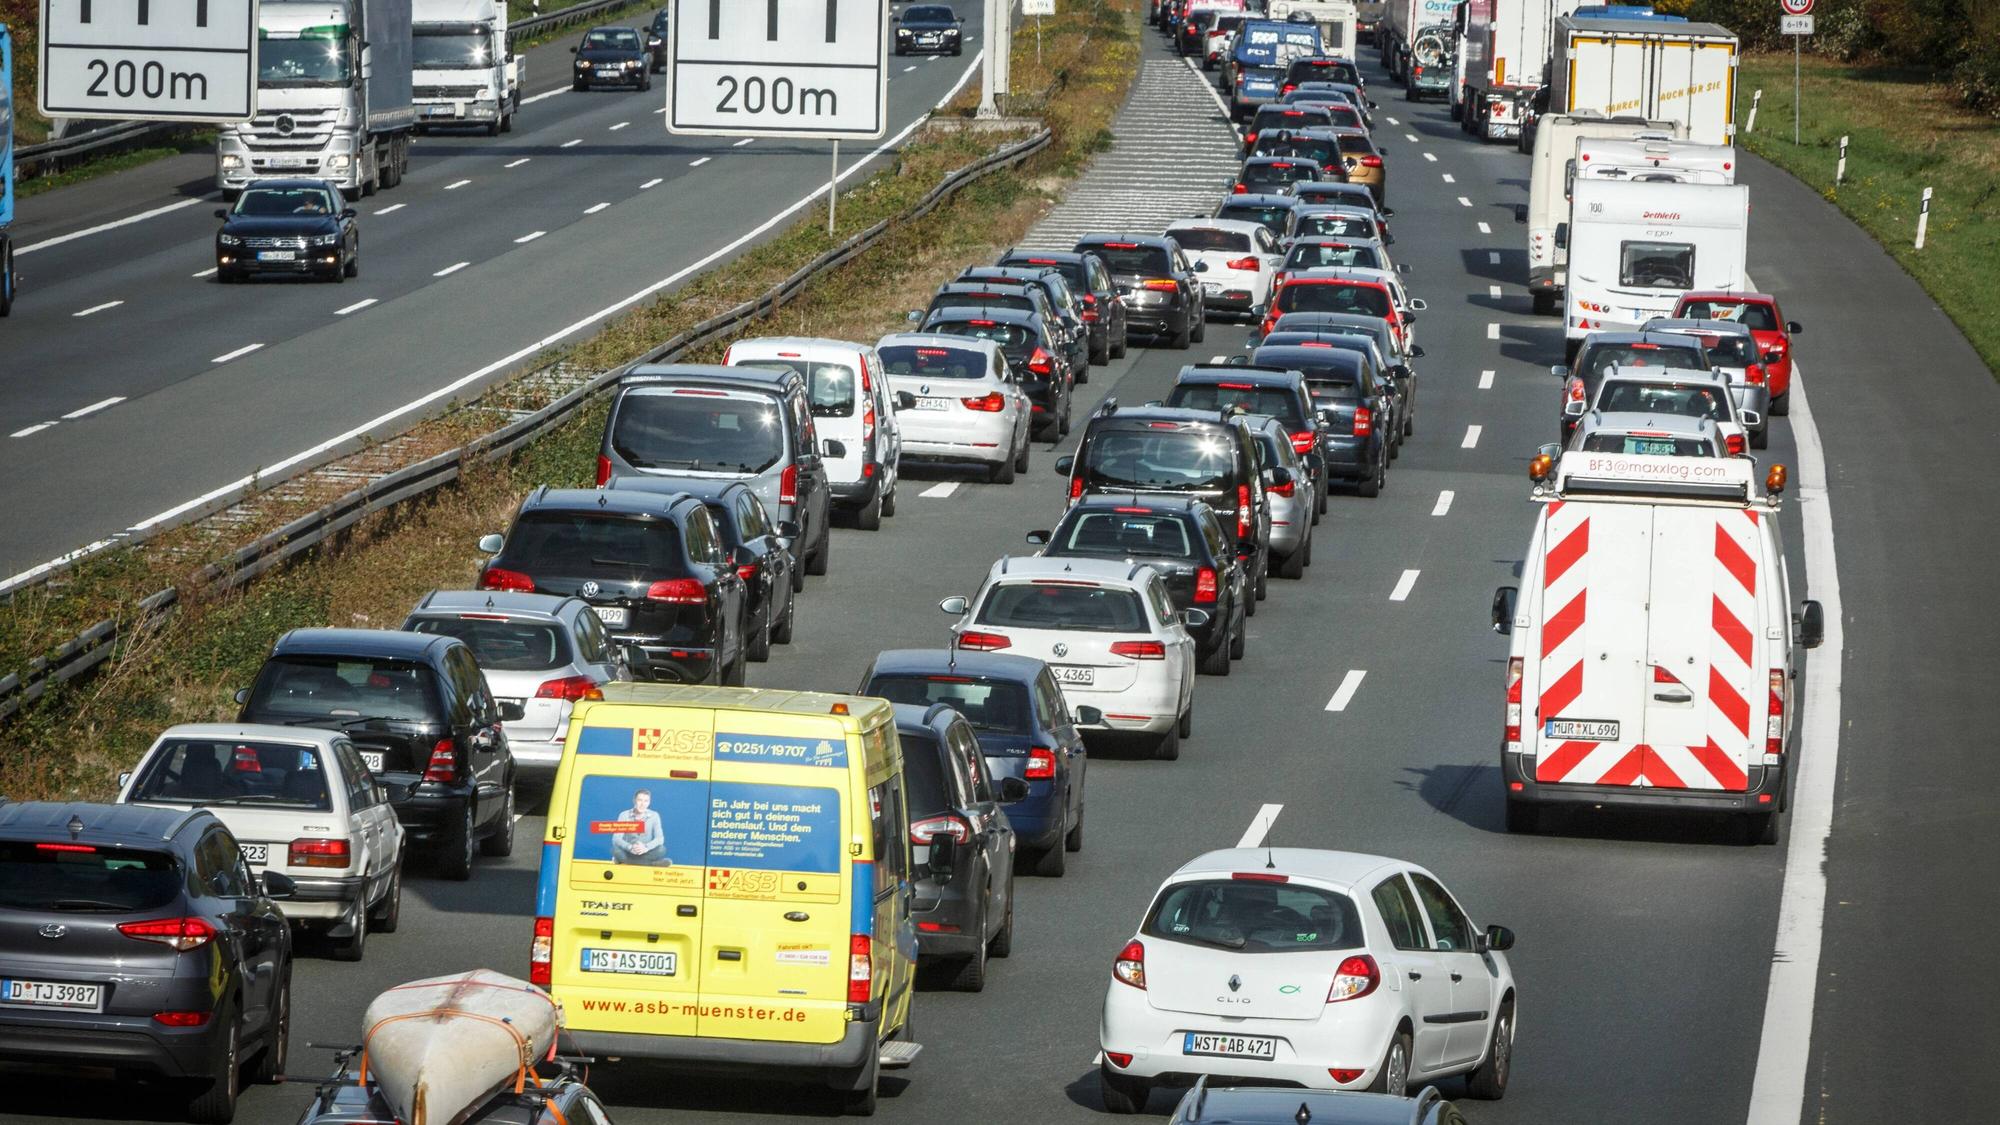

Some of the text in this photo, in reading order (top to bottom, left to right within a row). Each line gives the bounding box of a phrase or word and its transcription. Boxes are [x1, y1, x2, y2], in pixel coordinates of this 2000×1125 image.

[87, 59, 207, 100] 200m
[716, 75, 837, 116] 200m
[1605, 99, 1640, 113] FAHREN
[1660, 88, 1684, 101] AUCH
[1706, 81, 1721, 92] SIE
[1643, 211, 1680, 220] Dethleffs
[933, 400, 948, 409] 341
[1589, 460, 1725, 479] BF3@maxxlog.com
[1063, 669, 1091, 681] 4365
[1582, 723, 1595, 735] XL
[1597, 724, 1617, 736] 696
[653, 730, 712, 753] ASB
[733, 743, 807, 757] 0251/19707
[712, 798, 821, 813] Ein Jahr bei uns macht
[712, 810, 800, 822] sich gut in deinem
[711, 820, 811, 833] Lebenslauf. Und dem
[711, 831, 801, 842] anderer Menschen.
[243, 845, 266, 860] 323
[726, 870, 777, 892] ASB
[580, 900, 633, 911] TRANSIT
[591, 951, 673, 971] MS AS 5001
[13, 982, 96, 1003] D TJ 3987
[1217, 996, 1251, 1004] CLIO
[582, 1000, 806, 1022] www.asb-muenster.de
[1194, 1036, 1271, 1055] WST AB 471
